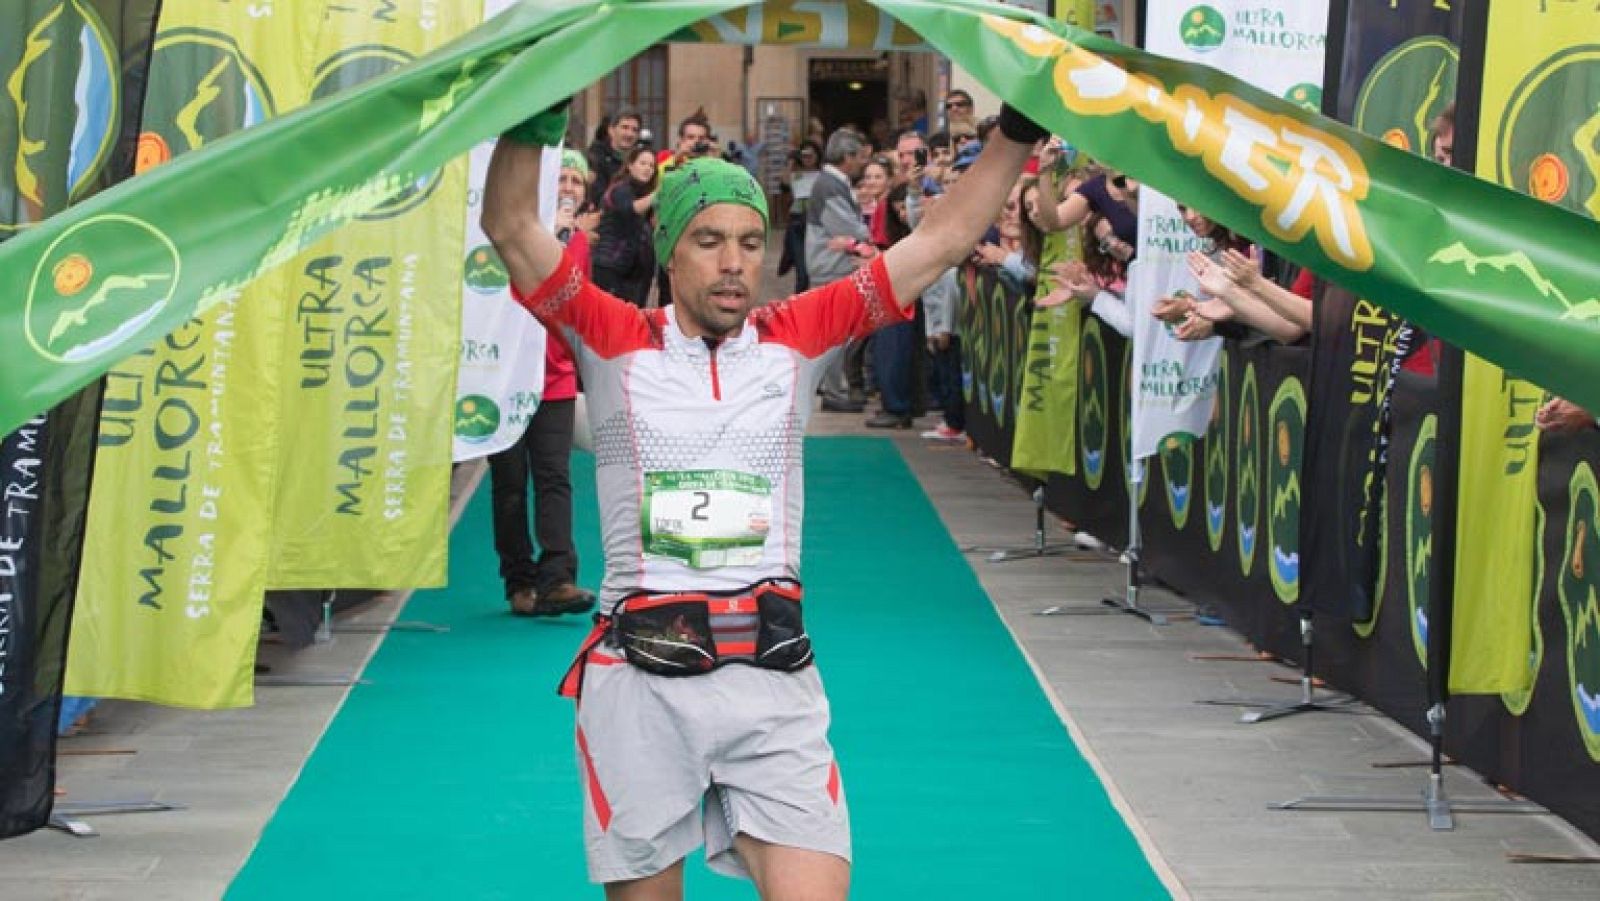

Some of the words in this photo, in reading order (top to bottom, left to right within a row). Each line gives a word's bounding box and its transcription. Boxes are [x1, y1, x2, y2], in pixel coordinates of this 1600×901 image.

[1234, 8, 1285, 28] ULTRA
[298, 255, 343, 389] ULTRA
[336, 256, 392, 516] MALLORCA
[389, 413, 409, 443] DE
[199, 484, 221, 520] DE
[383, 448, 410, 522] SERRA
[691, 491, 711, 521] 2
[184, 532, 216, 621] SERRA
